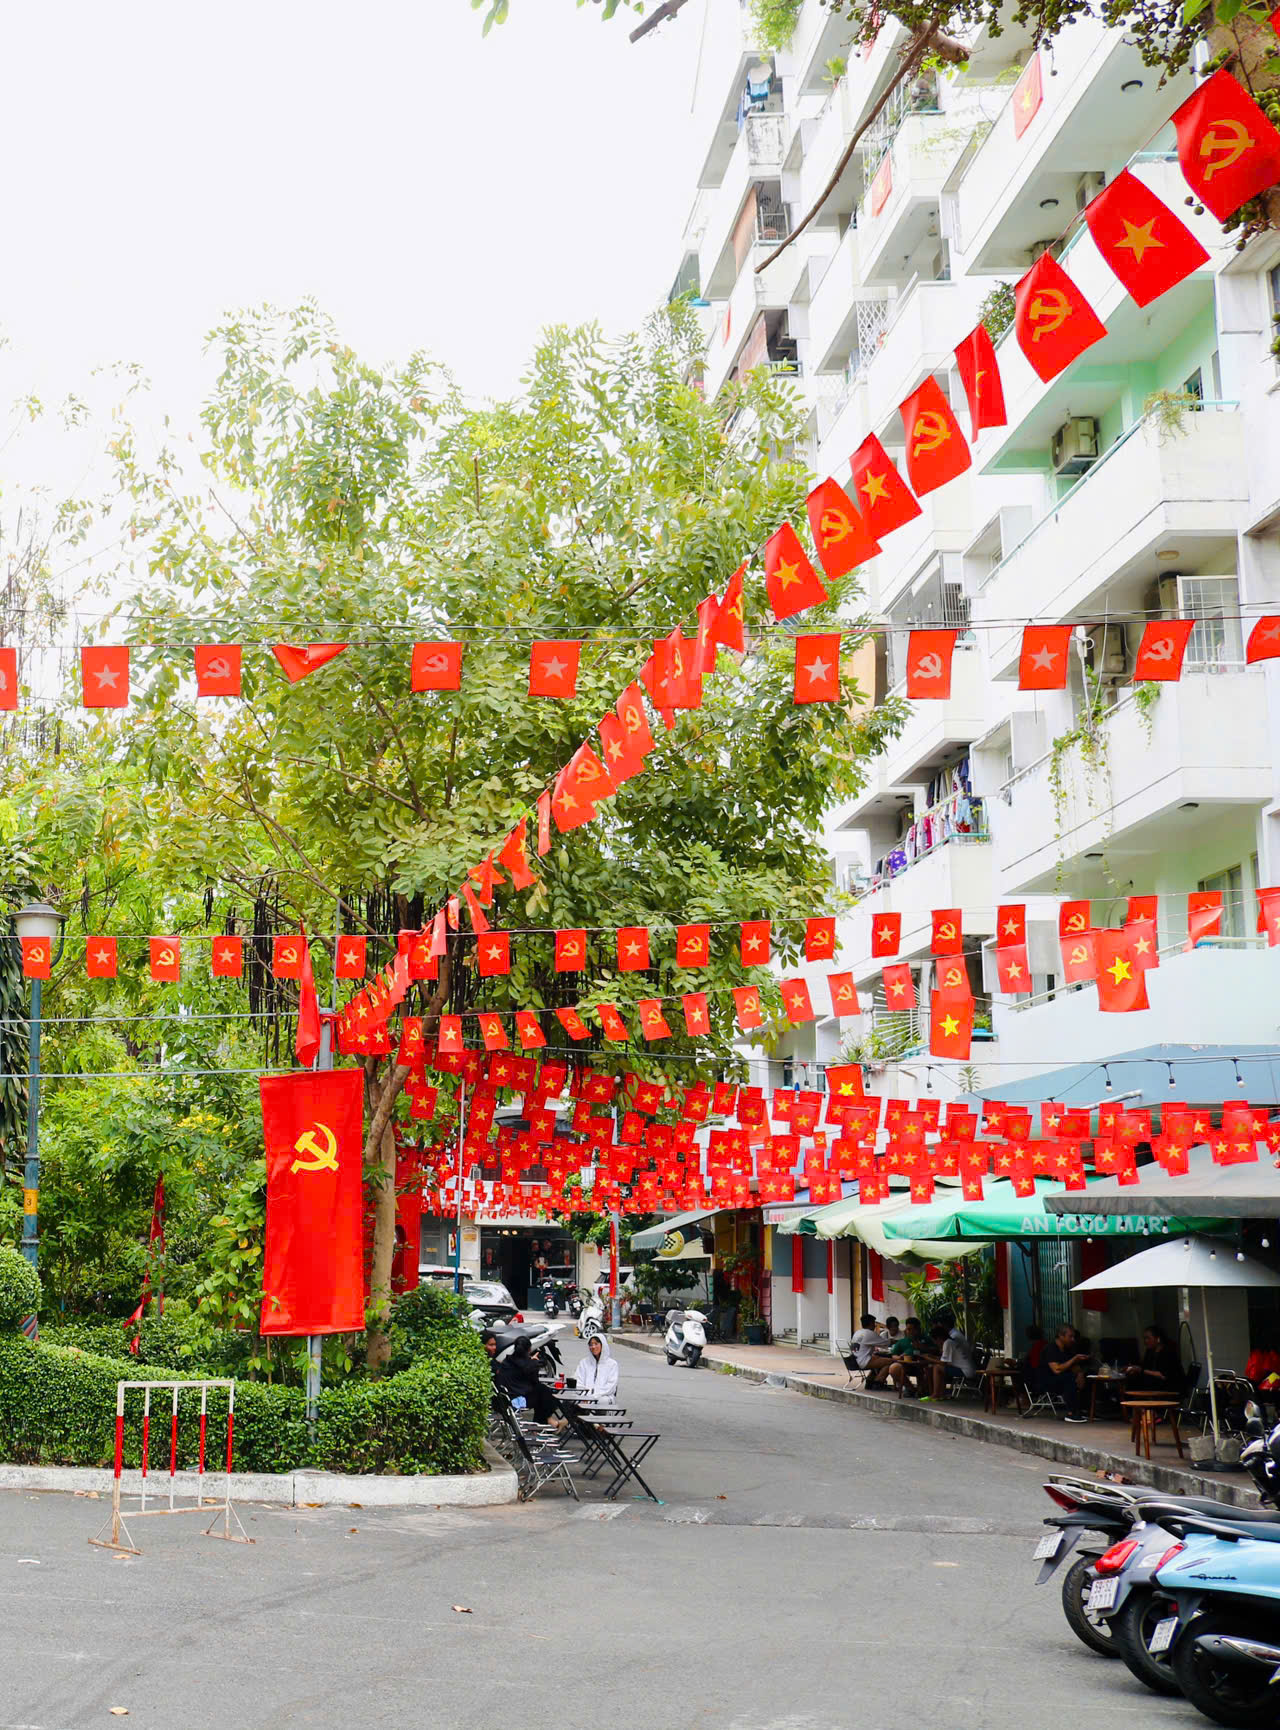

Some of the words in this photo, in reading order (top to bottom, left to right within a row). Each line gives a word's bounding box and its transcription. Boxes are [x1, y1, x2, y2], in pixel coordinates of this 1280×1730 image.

[27, 1198, 32, 1206] 3
[1021, 1217, 1050, 1233] AN
[1056, 1215, 1107, 1233] FOOD
[1115, 1215, 1170, 1234] MART
